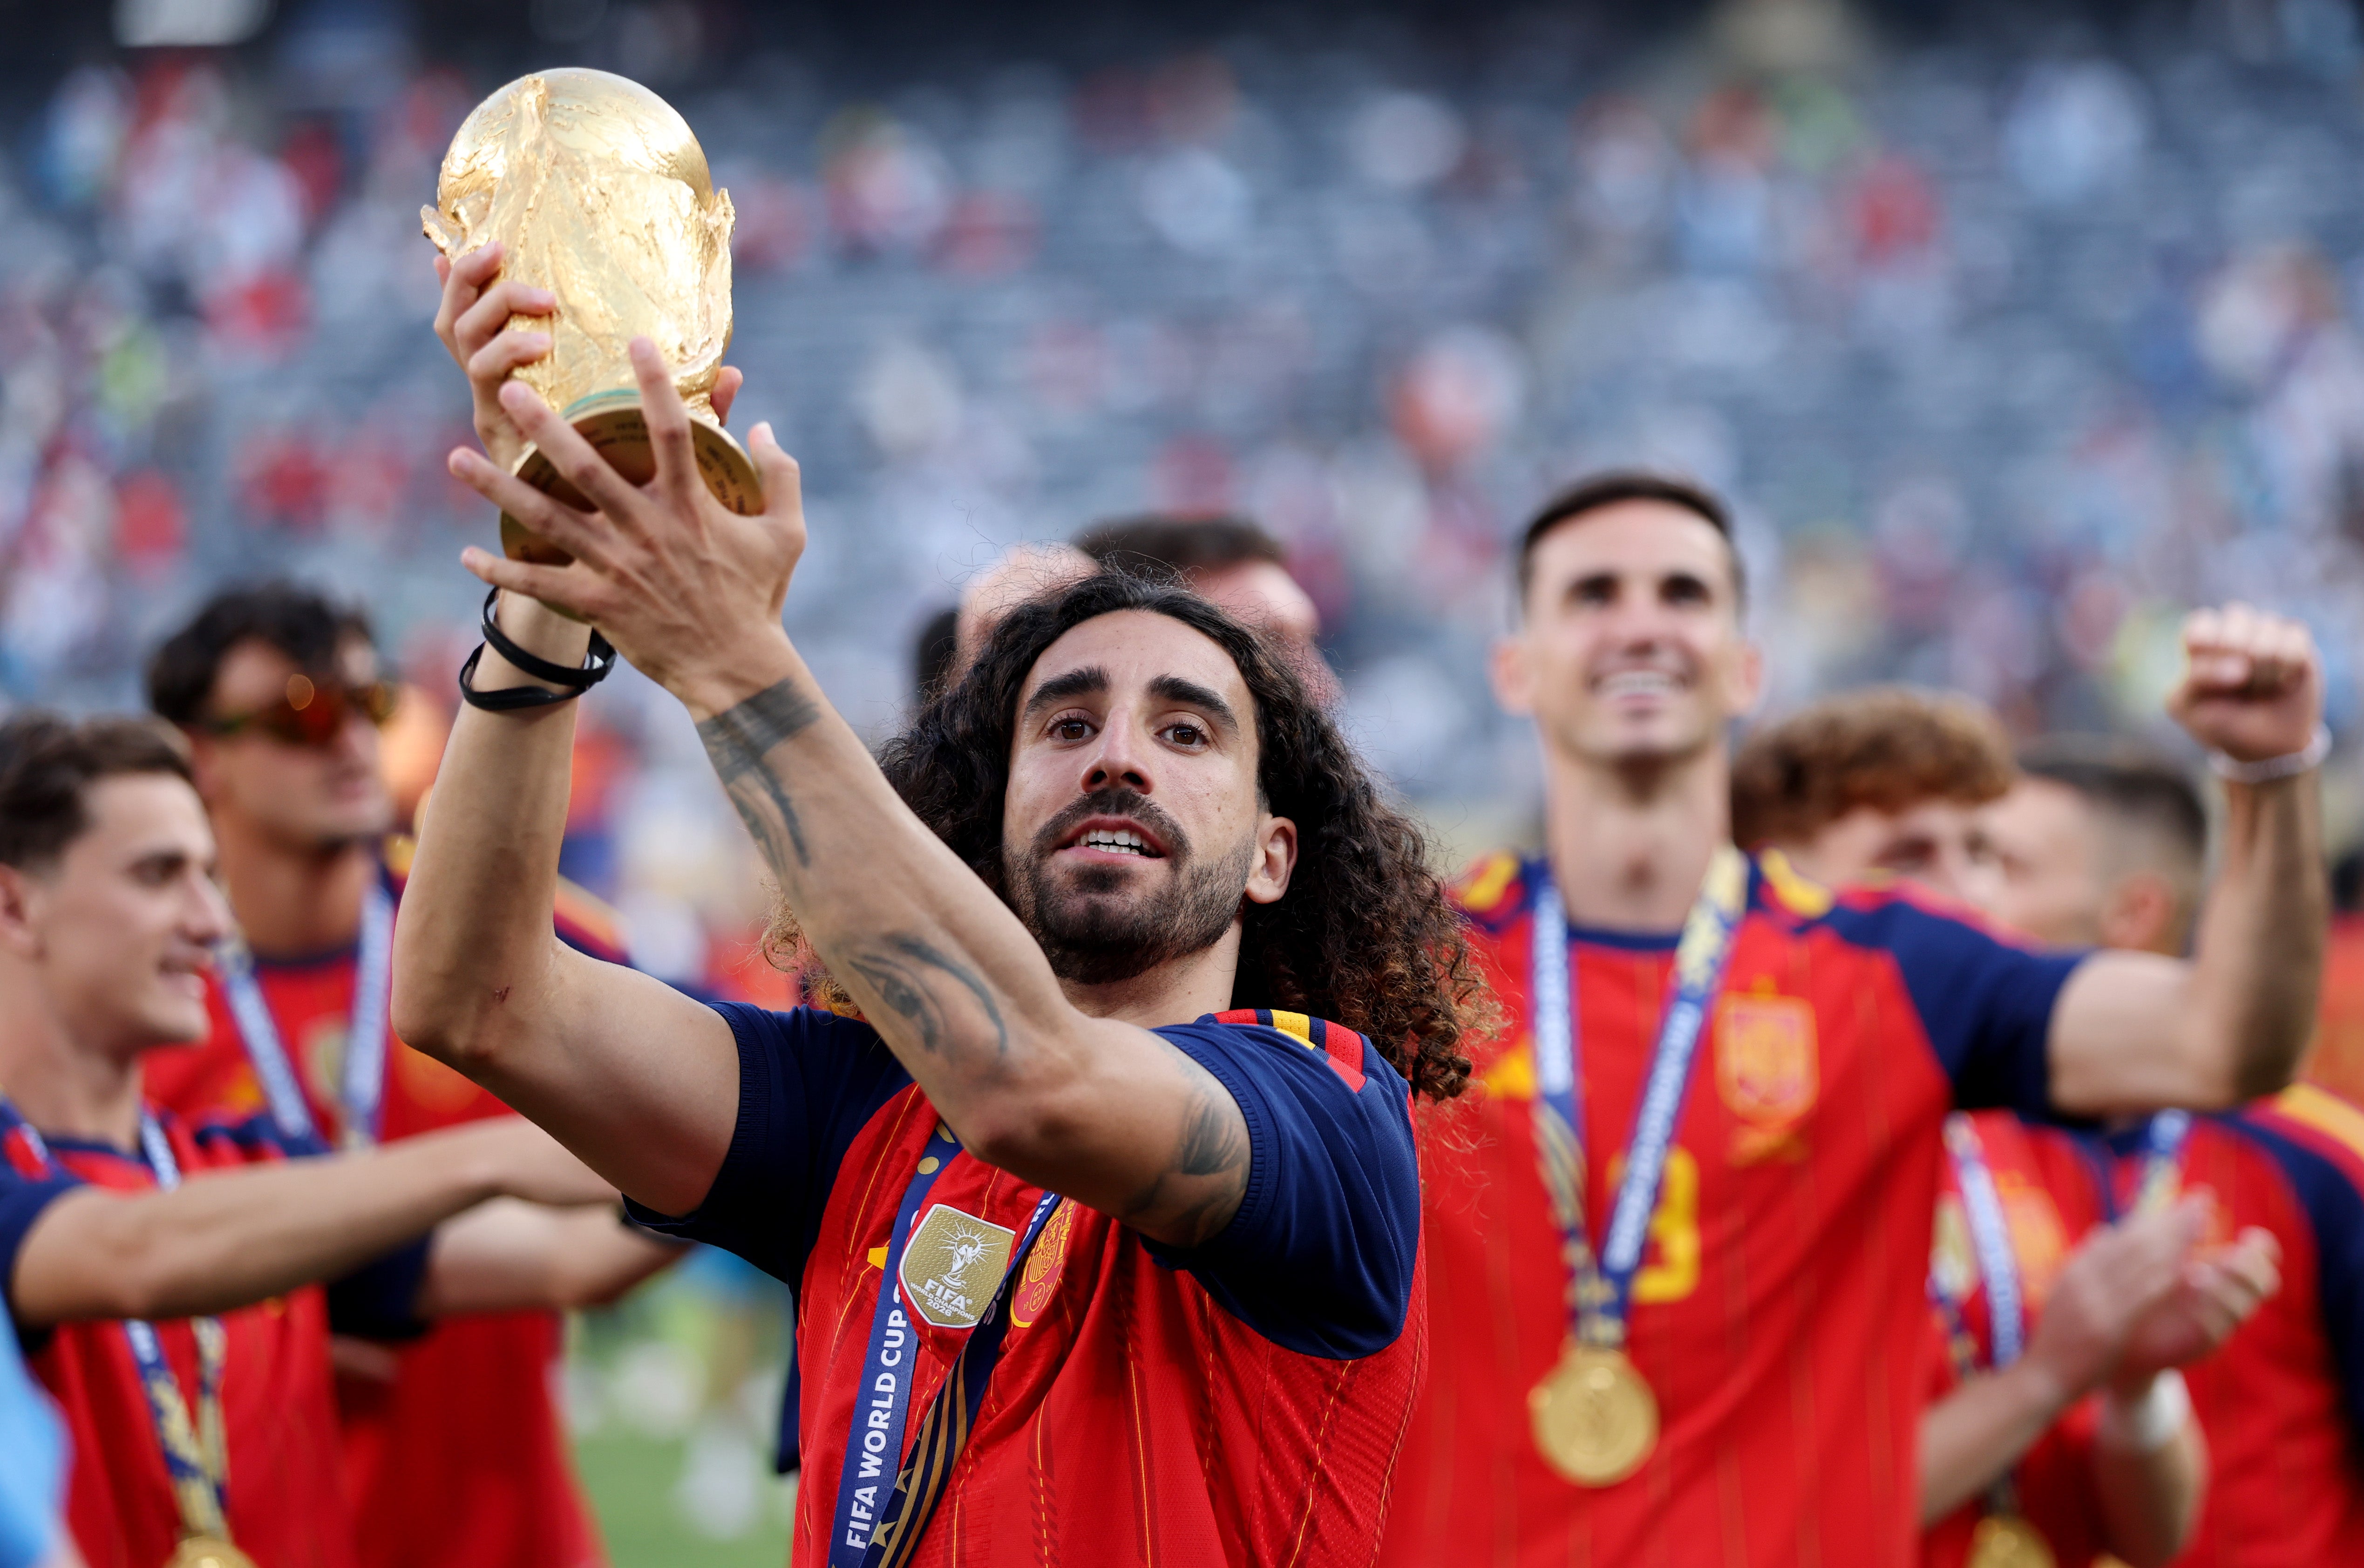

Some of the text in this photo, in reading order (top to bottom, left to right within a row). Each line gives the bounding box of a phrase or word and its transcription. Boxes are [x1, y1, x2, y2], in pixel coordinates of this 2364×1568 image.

[910, 1282, 934, 1299] WORLD
[934, 1296, 975, 1321] CHAMPIONS
[926, 1298, 952, 1317] 2026
[881, 1310, 908, 1367] CUP
[858, 1372, 897, 1479] WORLD
[845, 1484, 878, 1550] FIFA
